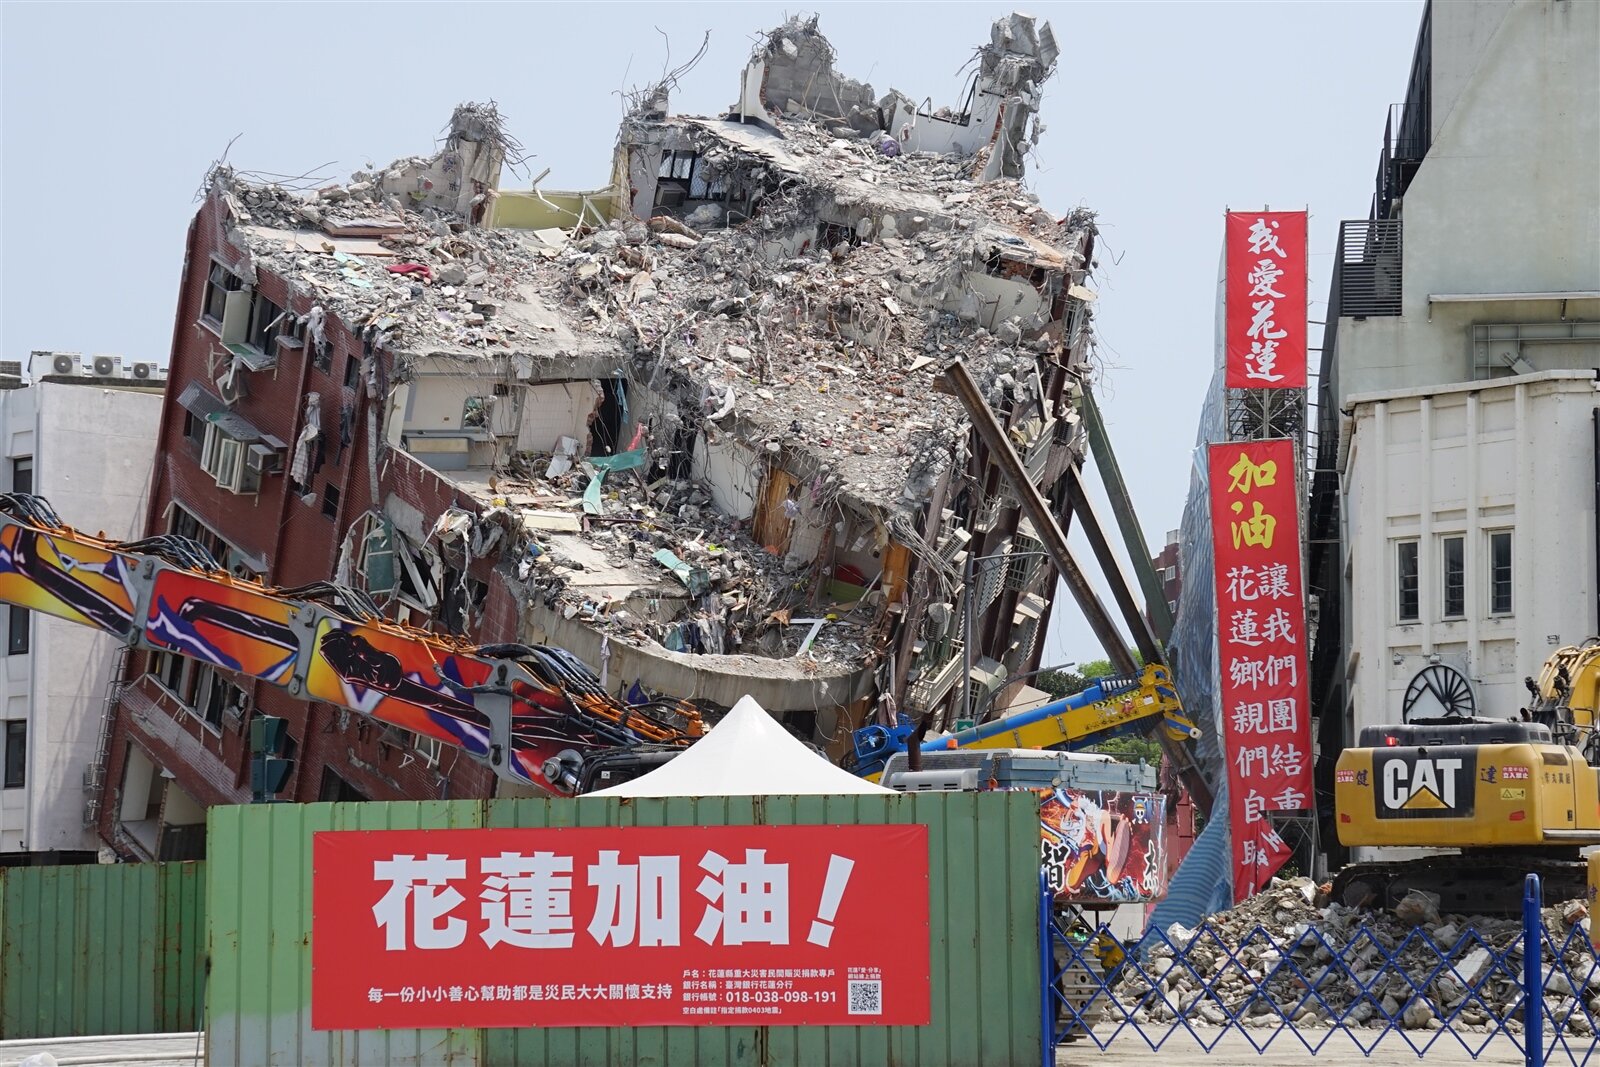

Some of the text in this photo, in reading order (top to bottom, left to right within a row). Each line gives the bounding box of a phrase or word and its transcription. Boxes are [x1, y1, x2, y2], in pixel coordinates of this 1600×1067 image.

[1245, 217, 1288, 383] 我愛花蓮
[1228, 452, 1277, 551] 加油
[1383, 758, 1463, 810] CAT
[372, 848, 856, 951] 花蓮加油！
[367, 983, 673, 1004] 每一份小小善心幫助都是災民大大關懷支持
